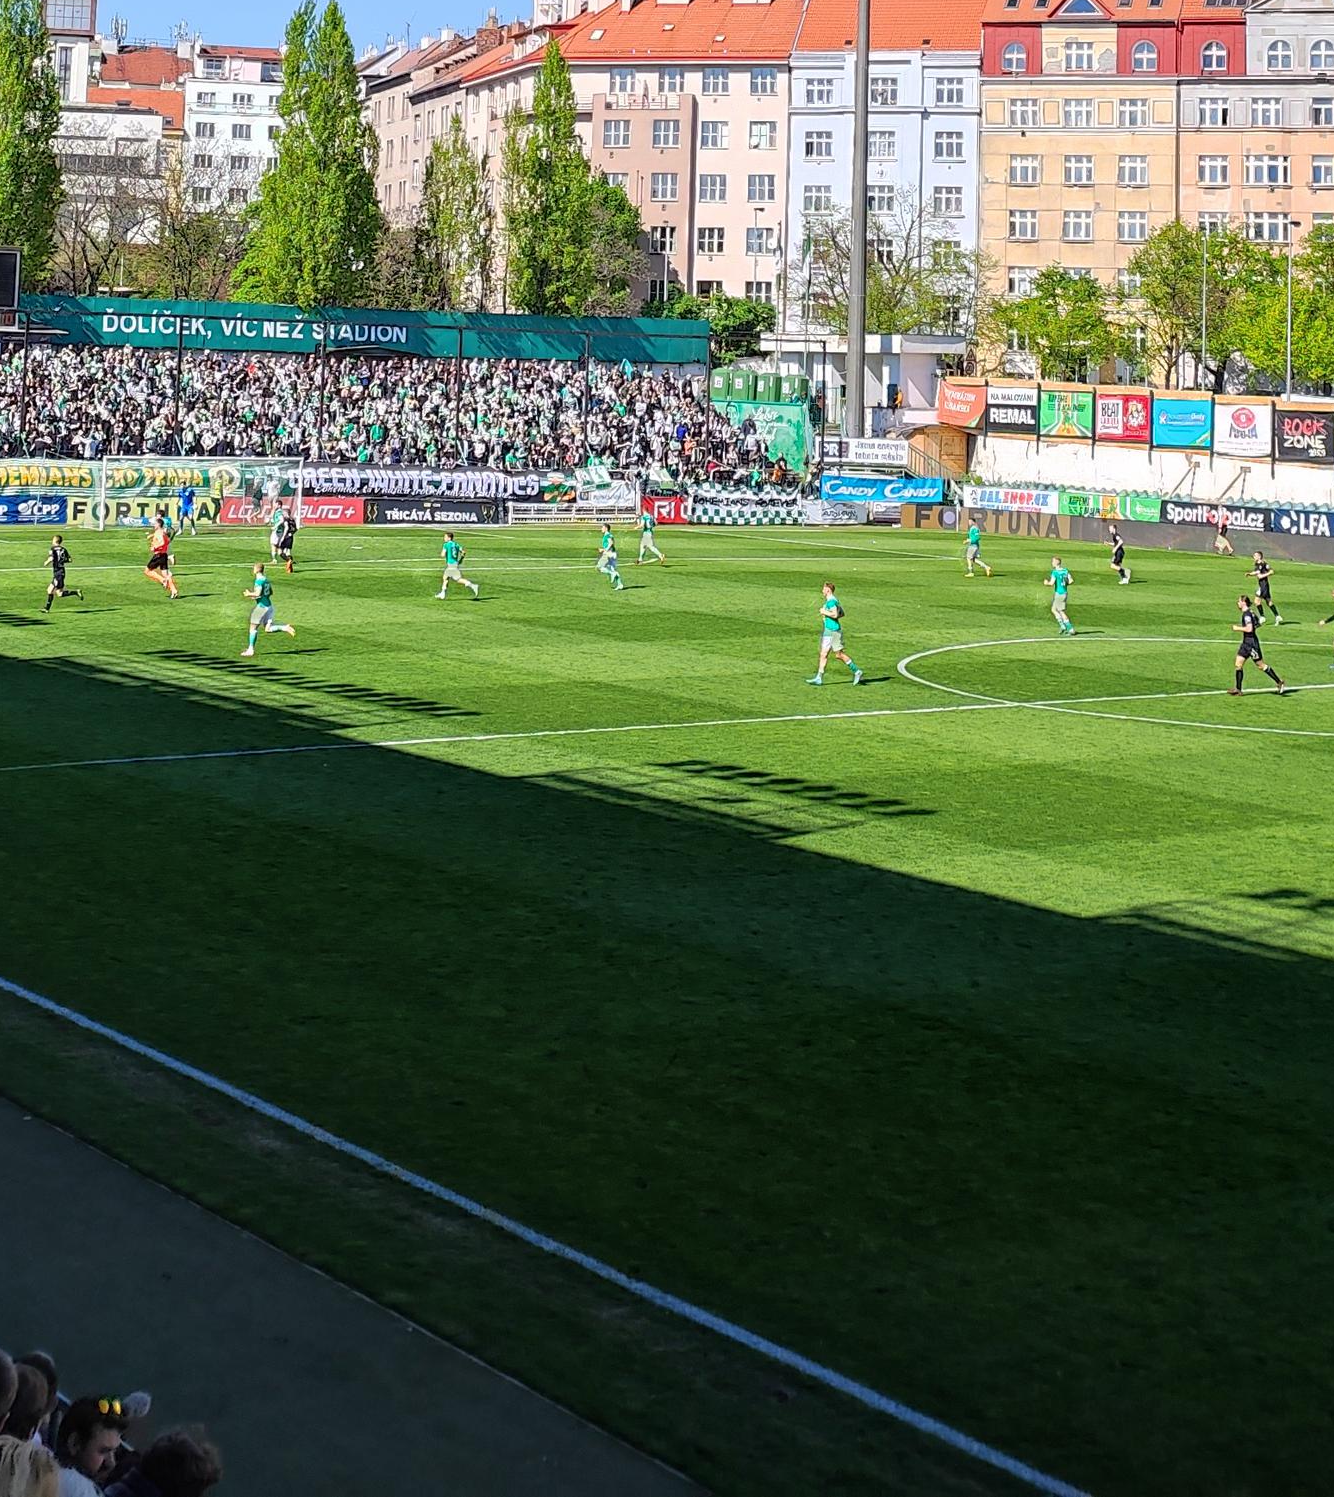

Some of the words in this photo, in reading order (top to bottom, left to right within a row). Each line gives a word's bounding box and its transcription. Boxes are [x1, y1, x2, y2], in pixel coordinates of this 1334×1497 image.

[101, 308, 213, 340] ĎOLÍČEK,
[220, 312, 257, 338] VÍC
[262, 314, 305, 340] NEŽ
[311, 320, 408, 344] STADION
[989, 407, 1036, 425] REMAL
[1282, 417, 1328, 436] ROCK
[1283, 435, 1327, 449] ZONE
[143, 467, 204, 488] PRAHA
[825, 479, 877, 498] CANDY
[883, 483, 939, 499] CANDY
[33, 501, 60, 515] ČPP
[385, 509, 433, 522] TŘICÁTÁ
[434, 510, 479, 523] SEZONA
[1299, 512, 1331, 537] LFA
